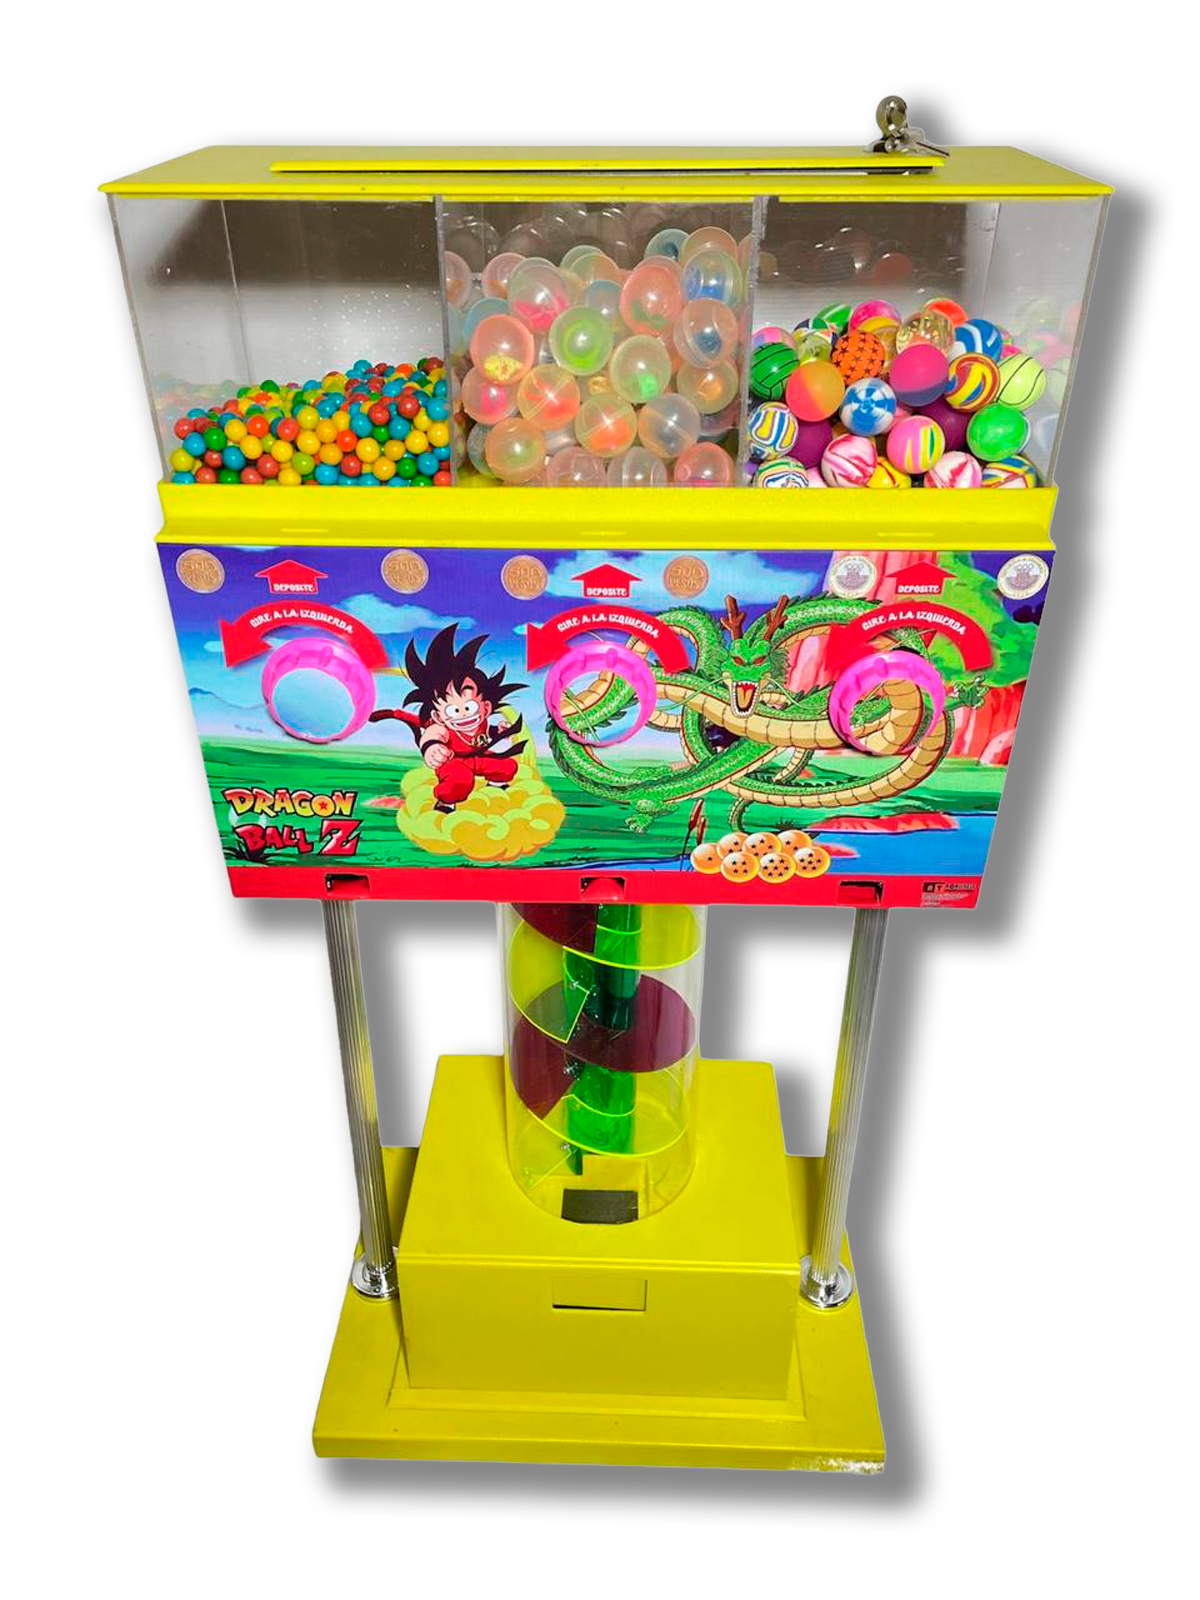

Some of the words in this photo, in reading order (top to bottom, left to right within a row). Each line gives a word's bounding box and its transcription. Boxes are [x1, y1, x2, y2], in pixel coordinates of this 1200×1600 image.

[273, 583, 315, 592] DEPOSITE
[586, 587, 628, 596] DEPOSITE
[898, 585, 940, 593] DEPOSITE
[249, 612, 272, 628] GIRE
[273, 610, 283, 620] A
[283, 608, 298, 618] LA
[299, 609, 354, 634] IZQUIERDA
[557, 616, 580, 632] GIRE
[582, 614, 592, 623] A
[592, 612, 607, 622] LA
[608, 613, 660, 638] IZQUIERDA
[861, 615, 886, 630] GIRE
[888, 612, 898, 622] A
[899, 610, 916, 620] LA
[917, 611, 966, 635] IZQUIERDA
[221, 786, 358, 817] DRAGON
[232, 823, 314, 854] BALL
[318, 819, 363, 855] Z
